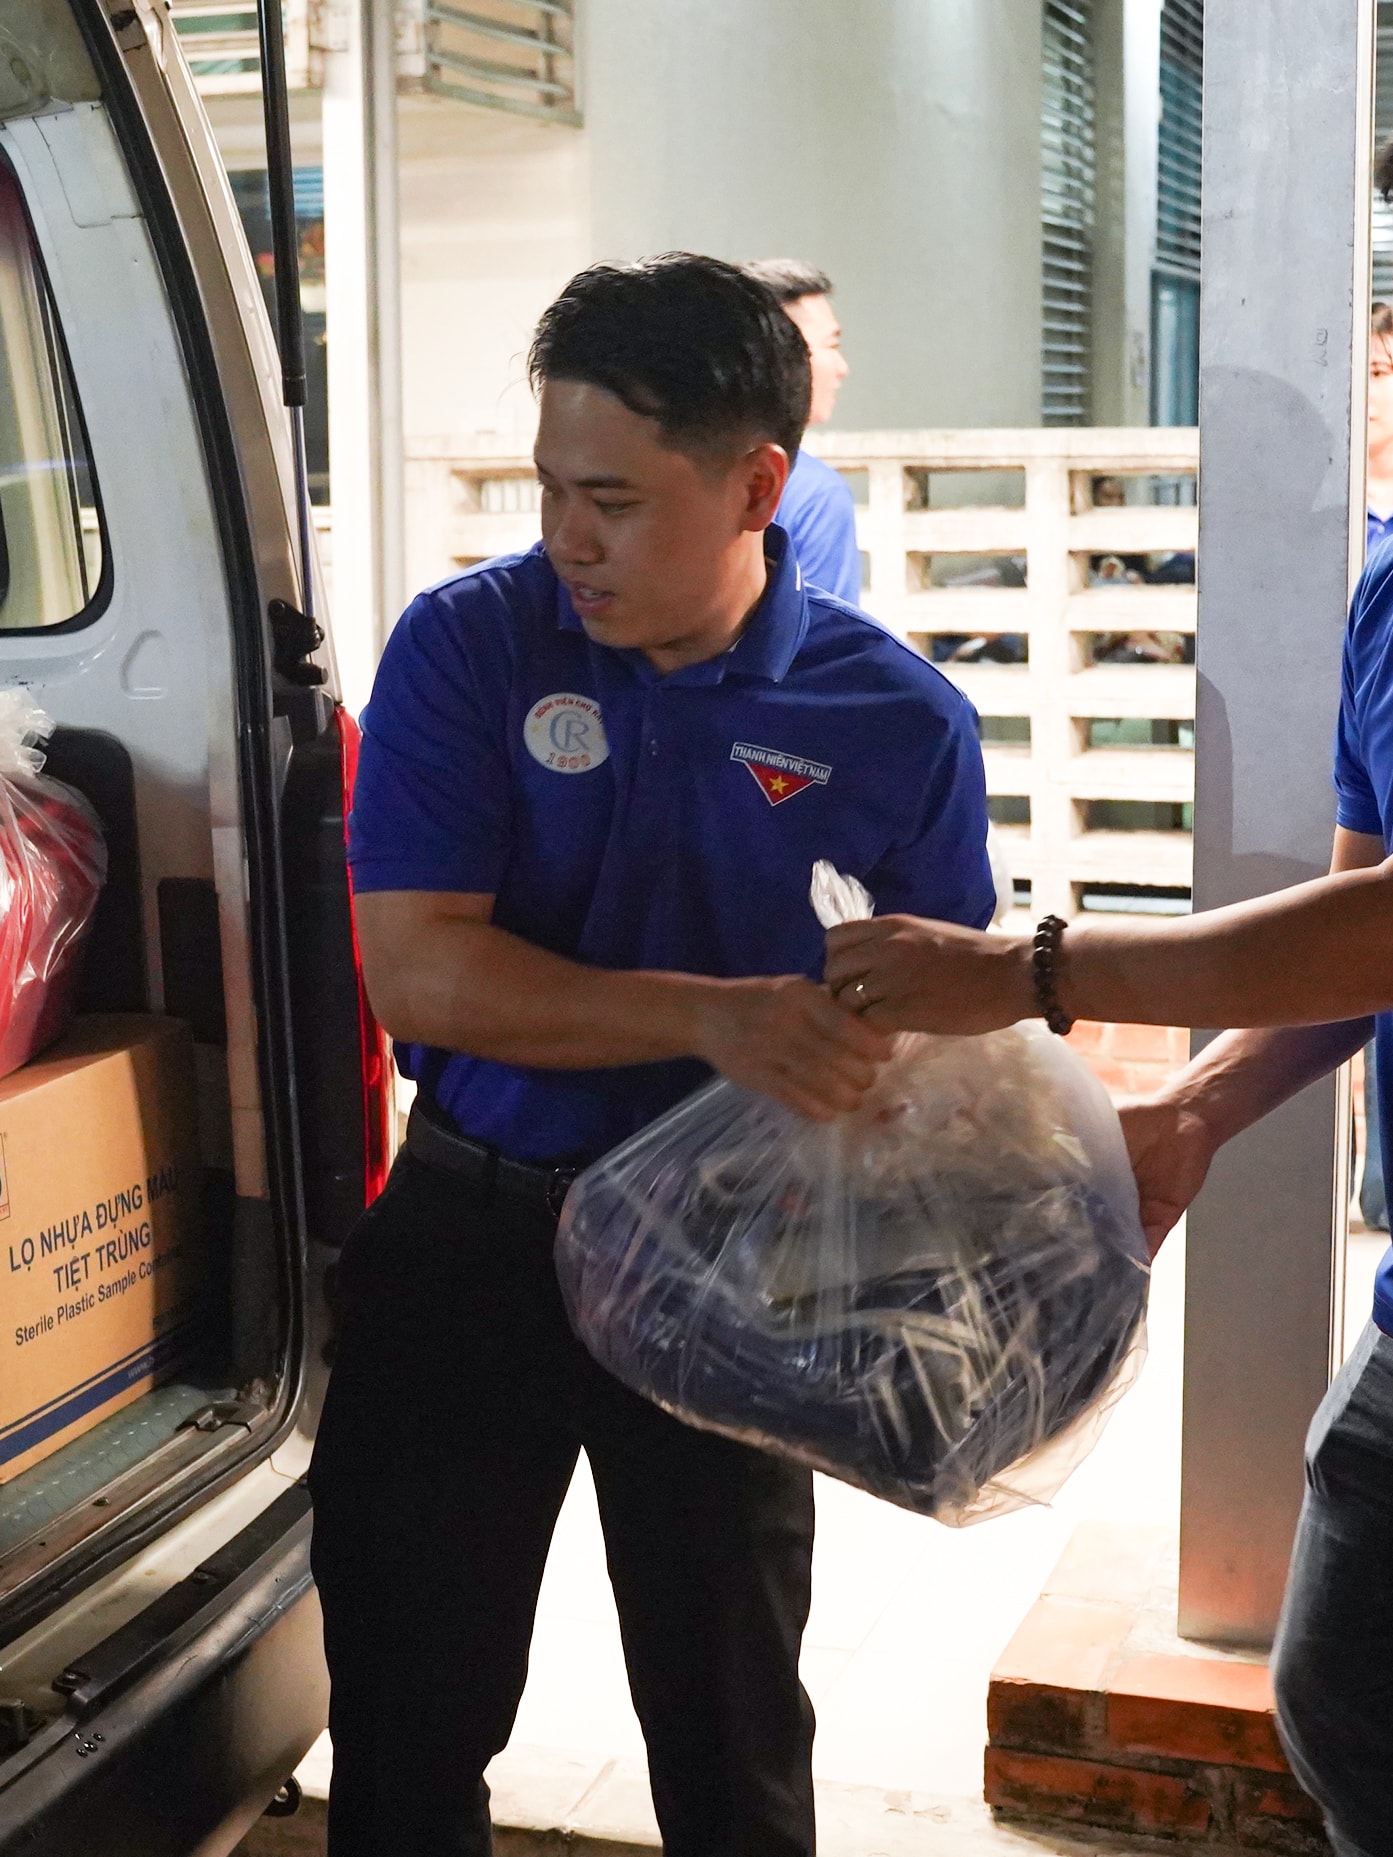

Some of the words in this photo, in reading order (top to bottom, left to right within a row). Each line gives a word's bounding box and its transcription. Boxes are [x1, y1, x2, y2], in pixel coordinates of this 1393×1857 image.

[734, 745, 766, 763] THANH
[765, 753, 788, 769] NIÊN
[787, 760, 809, 775] VIỆT
[807, 765, 828, 780] NAM
[9, 1238, 34, 1272] LỌ
[40, 1211, 93, 1257] NHỰA
[96, 1184, 143, 1230] ĐỰNG
[53, 1253, 91, 1293] TIỆT
[95, 1222, 151, 1272] TRÙNG
[15, 1314, 54, 1346] Sterile
[57, 1292, 95, 1325] Plastic
[98, 1268, 137, 1302] Sample
